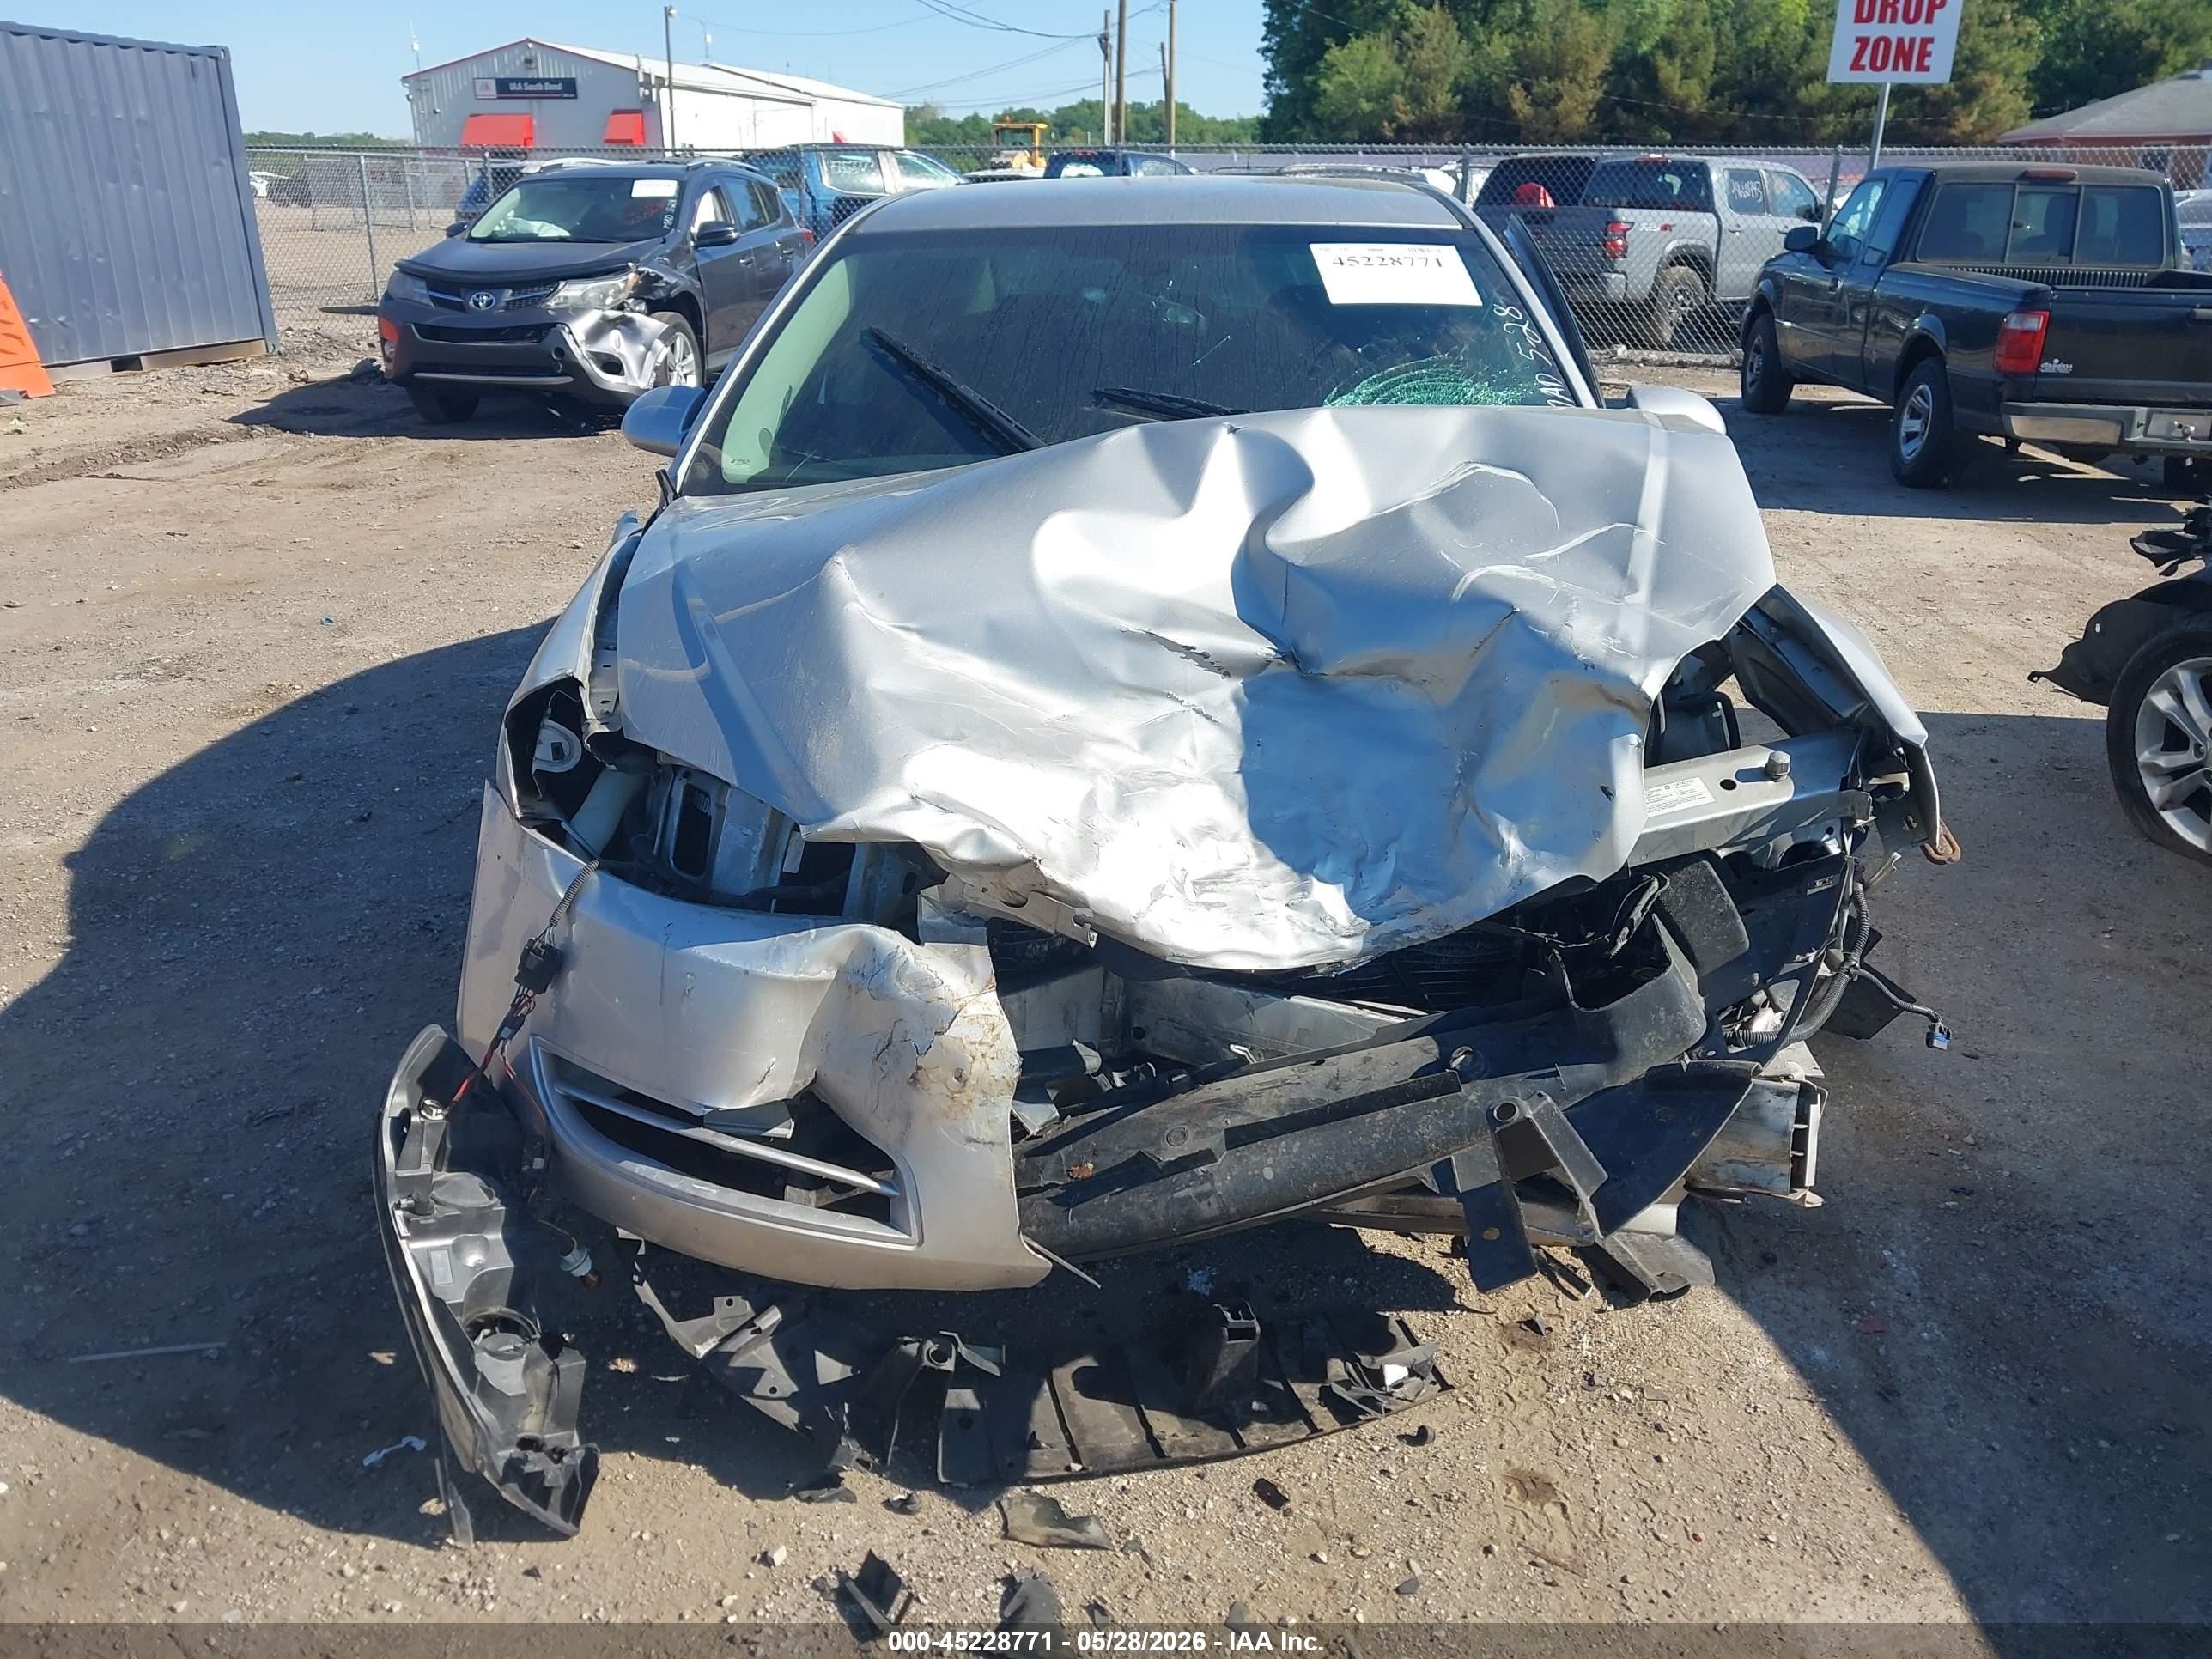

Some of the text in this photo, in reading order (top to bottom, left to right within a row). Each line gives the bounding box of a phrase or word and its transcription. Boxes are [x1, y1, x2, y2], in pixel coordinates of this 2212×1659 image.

[1854, 0, 1948, 24] DROP
[1850, 36, 1935, 72] ZONE
[1332, 256, 1443, 267] 45228771
